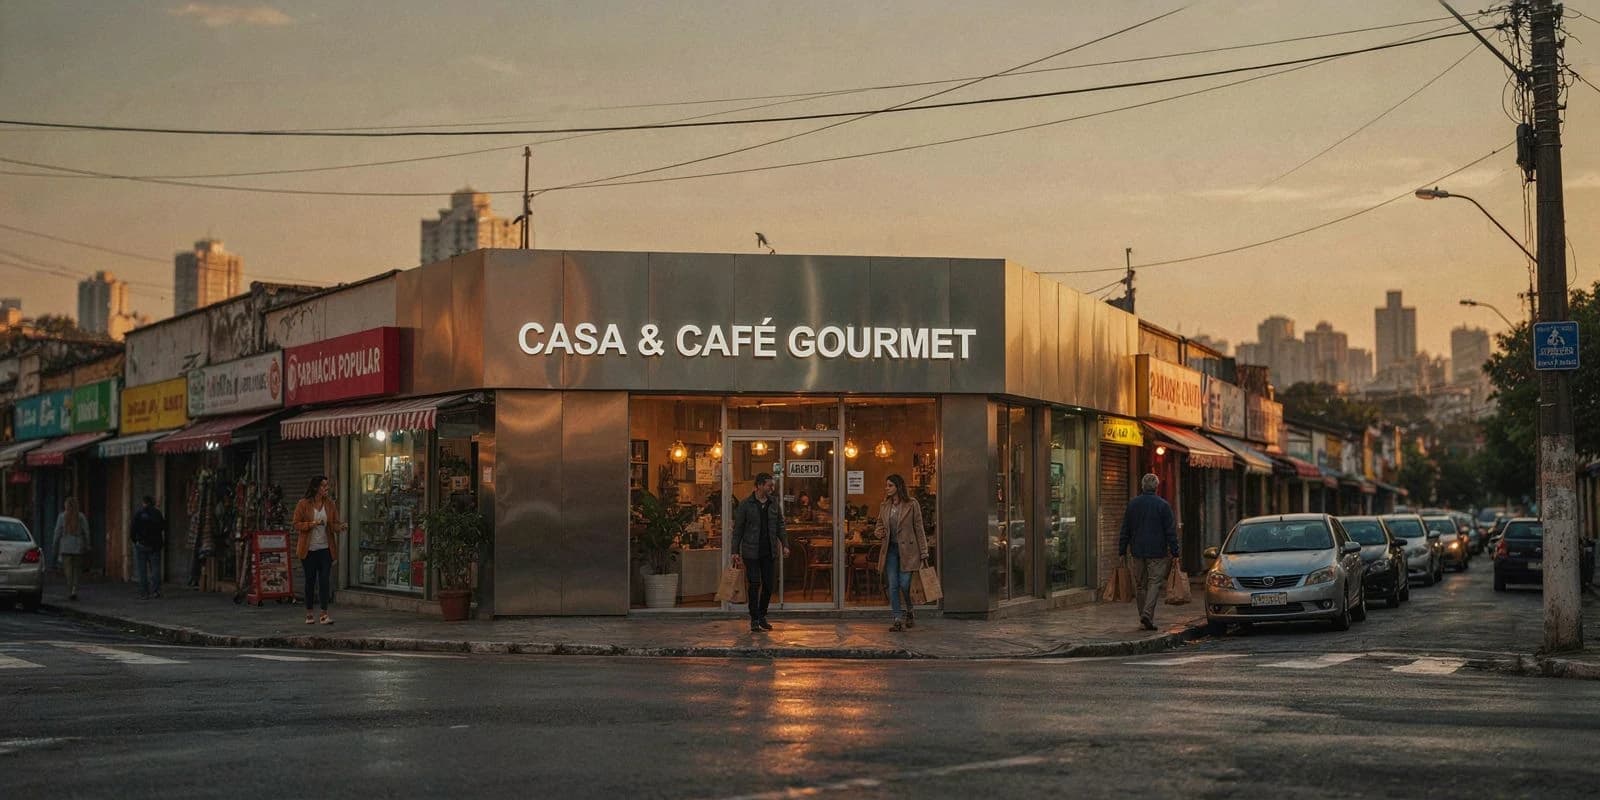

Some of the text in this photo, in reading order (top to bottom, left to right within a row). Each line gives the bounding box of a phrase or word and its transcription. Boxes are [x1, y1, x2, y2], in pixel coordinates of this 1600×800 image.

[518, 317, 977, 360] CASA & CAFÉ GOURMET
[338, 347, 381, 380] POPULAR
